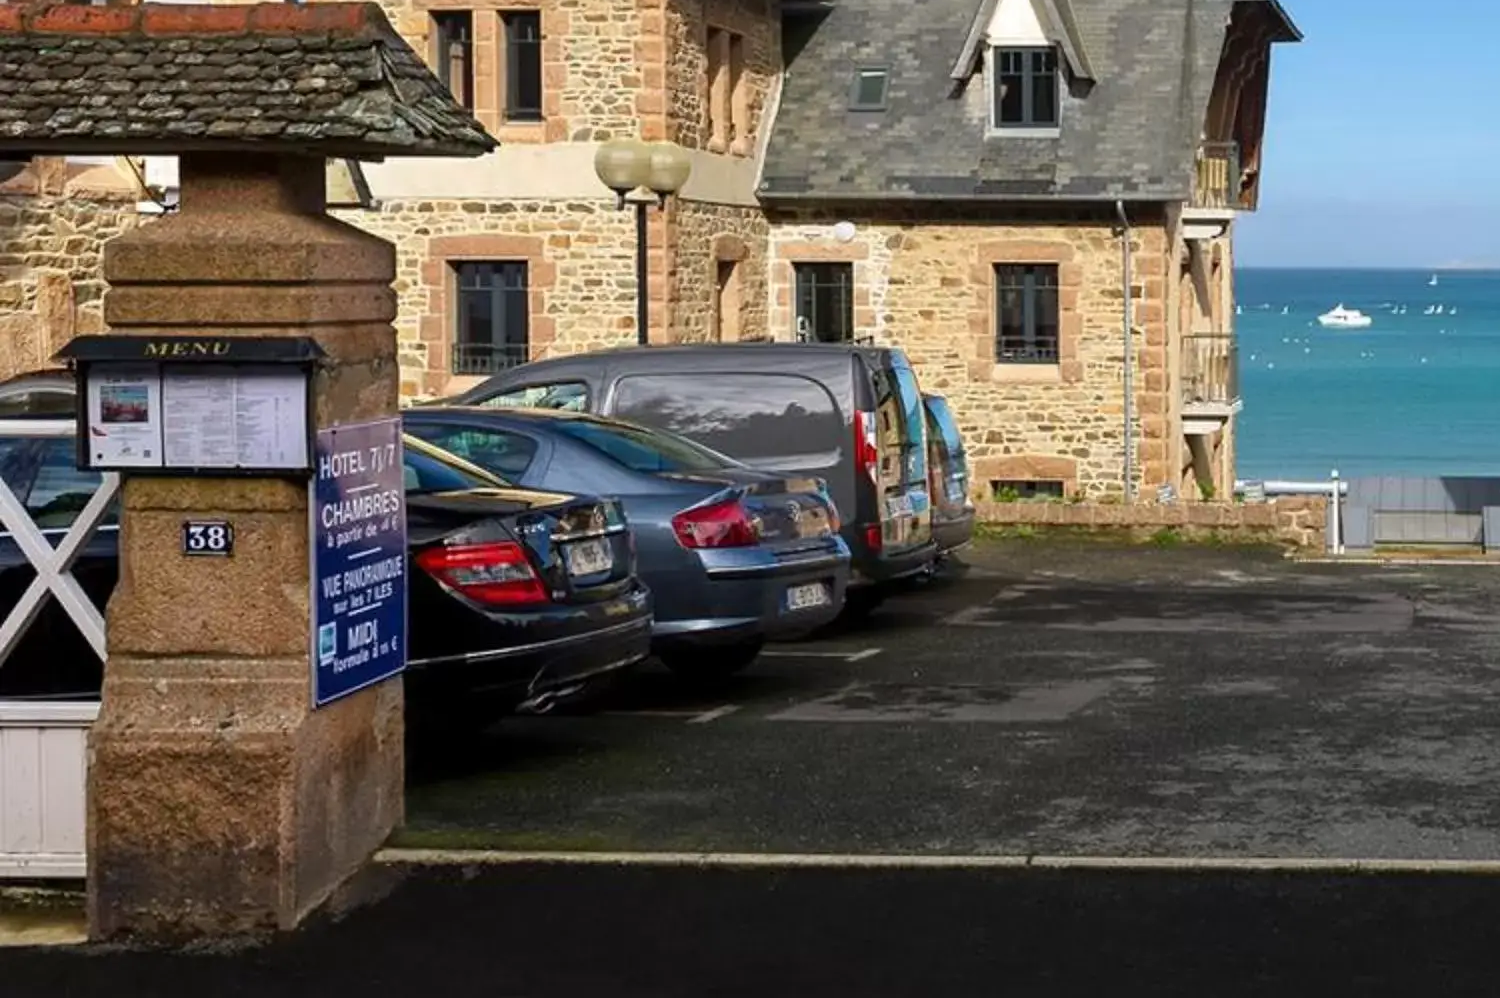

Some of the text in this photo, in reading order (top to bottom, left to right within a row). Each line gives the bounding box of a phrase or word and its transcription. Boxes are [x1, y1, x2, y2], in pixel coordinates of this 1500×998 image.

[144, 342, 231, 356] MENU
[320, 450, 366, 480] HOTEL
[322, 490, 399, 528] CHAMBRES
[189, 525, 225, 549] 38
[336, 524, 362, 549] partir
[365, 521, 378, 537] de
[322, 555, 402, 598] VUE PANORAMIQUE
[350, 593, 365, 609] les
[348, 618, 378, 651] MIDI
[333, 648, 369, 674] formule
